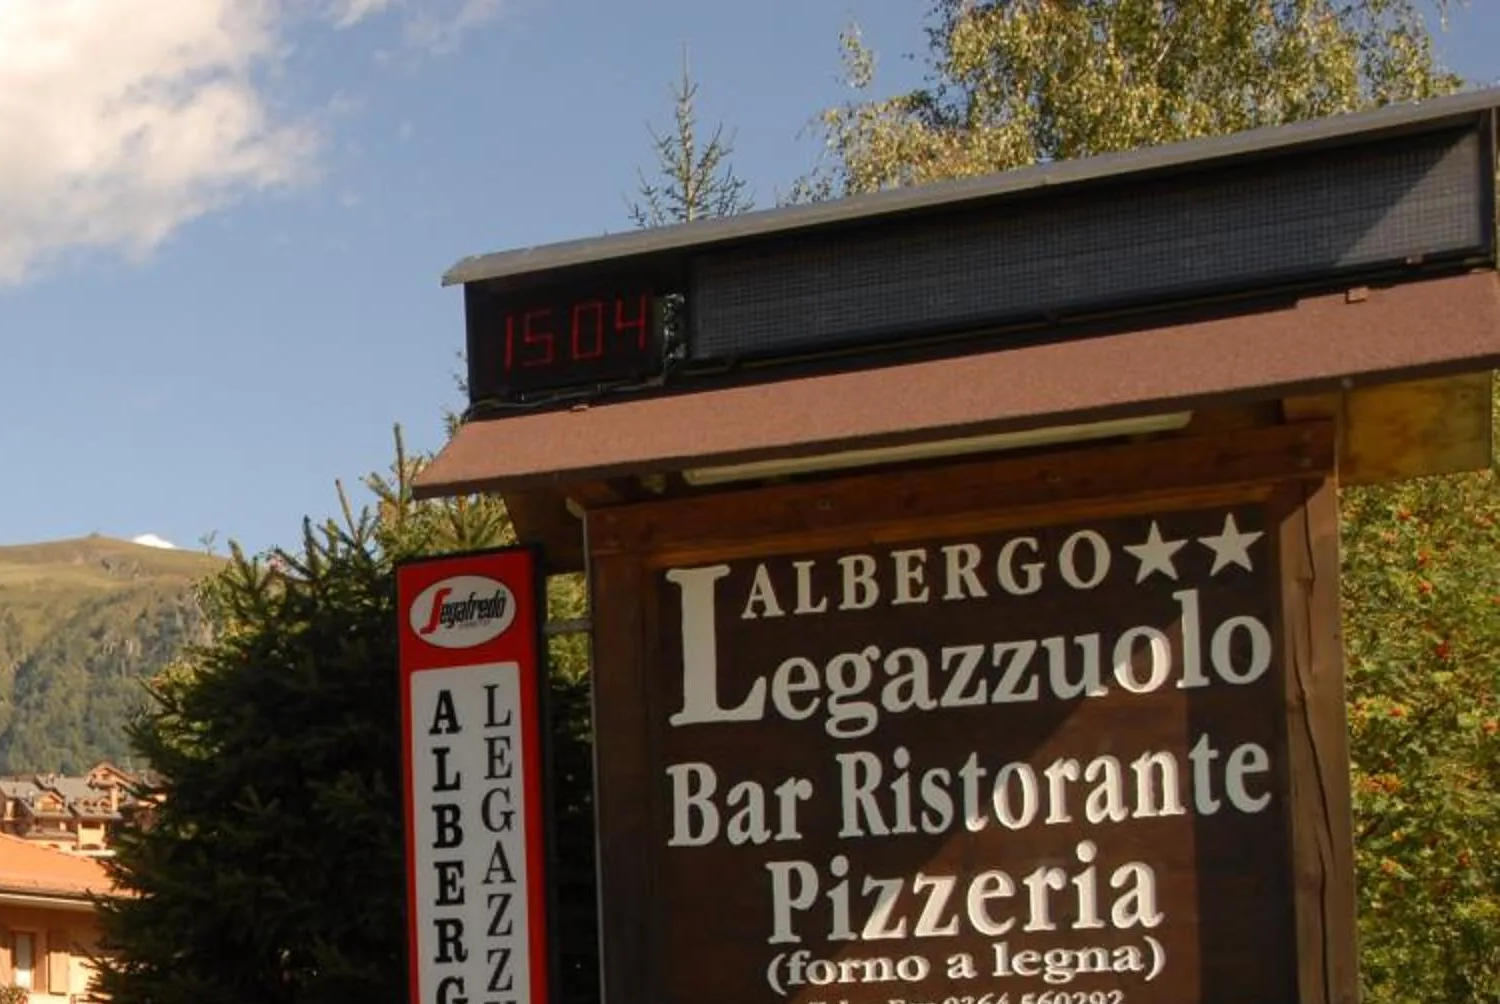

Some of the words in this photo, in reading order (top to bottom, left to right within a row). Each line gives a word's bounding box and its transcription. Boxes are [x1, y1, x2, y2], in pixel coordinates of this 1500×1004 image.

[419, 587, 507, 635] Segafredo
[741, 529, 1111, 619] ALBERGO
[665, 563, 1273, 739] Legazzuolo
[667, 762, 812, 848] Bar
[836, 732, 1273, 839] Ristorante
[765, 840, 1164, 945] Pizzeria
[767, 949, 931, 996] (forno
[947, 953, 978, 980] a
[992, 935, 1167, 985] legna)
